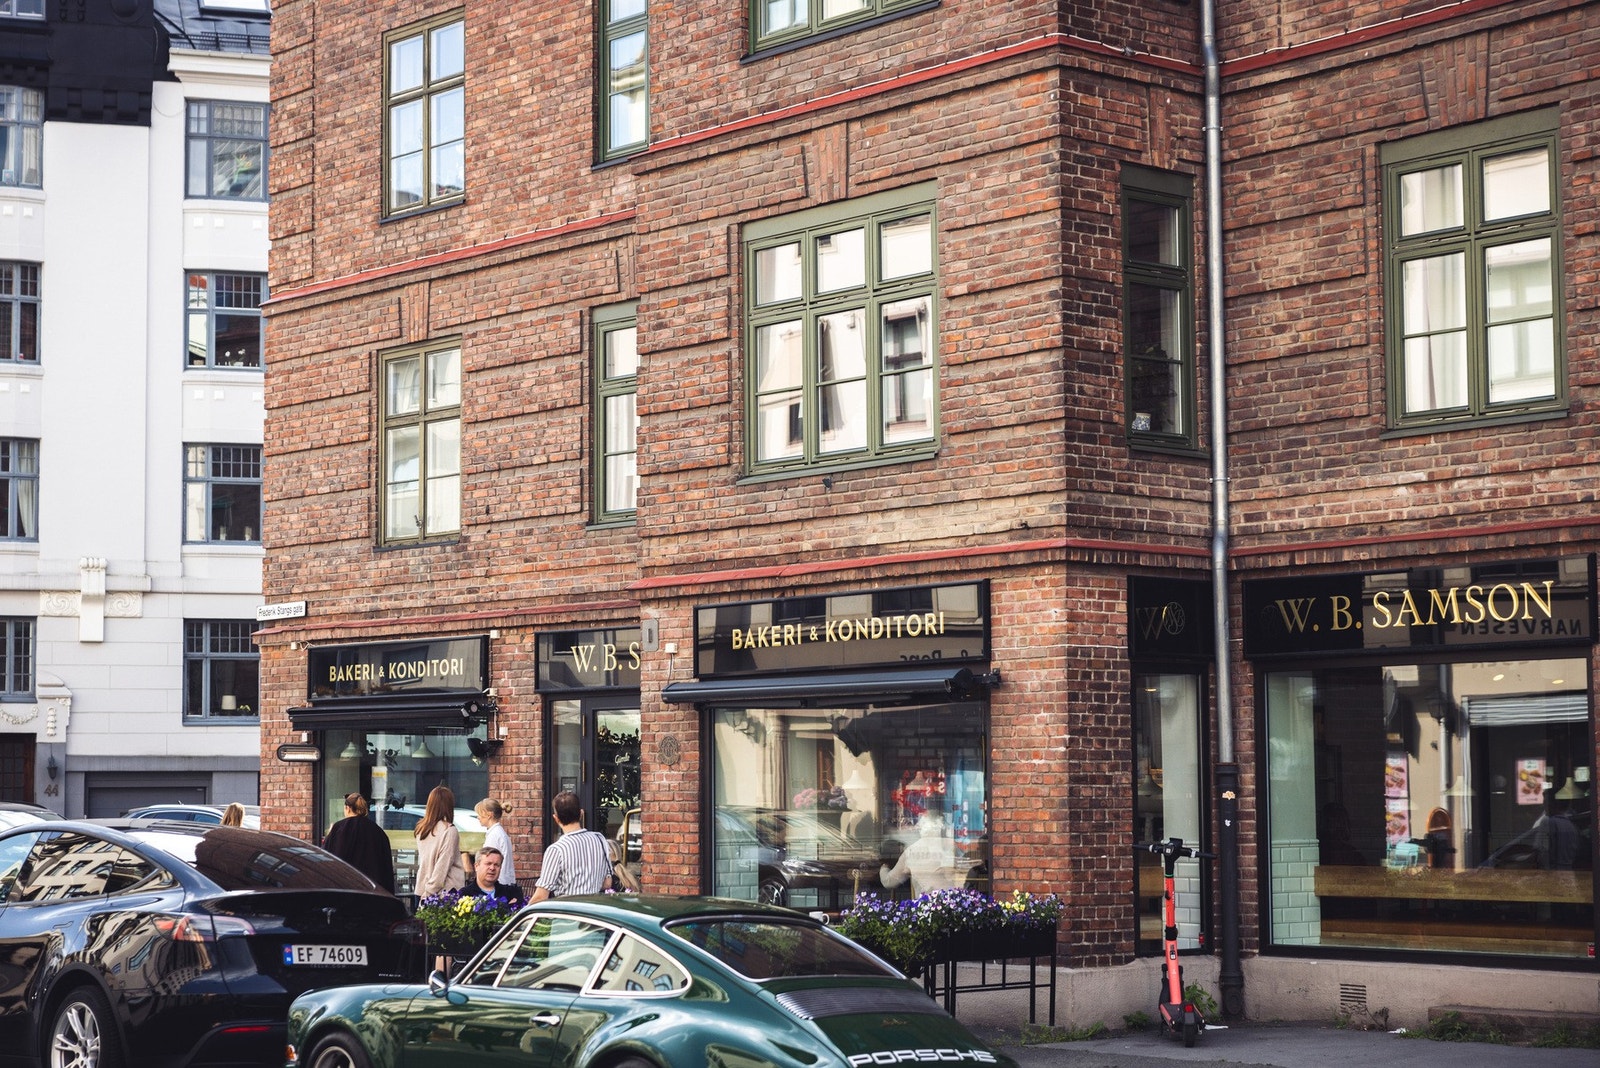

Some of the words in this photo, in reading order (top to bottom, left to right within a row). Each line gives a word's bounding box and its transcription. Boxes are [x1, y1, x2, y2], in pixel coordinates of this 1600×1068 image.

[1274, 597, 1319, 634] W.
[1330, 595, 1362, 631] B.
[1372, 580, 1554, 629] SAMSON
[731, 623, 802, 650] BAKERI
[809, 625, 819, 641] &
[825, 611, 945, 643] KONDITORI
[329, 663, 375, 682] BAKERI
[378, 665, 385, 678] &
[388, 658, 464, 679] KONDITORI
[570, 644, 598, 673] W.
[603, 643, 623, 671] B.
[43, 784, 58, 796] 44
[297, 948, 313, 962] EF
[319, 947, 363, 963] 74609
[848, 1048, 997, 1068] PORSCHE
